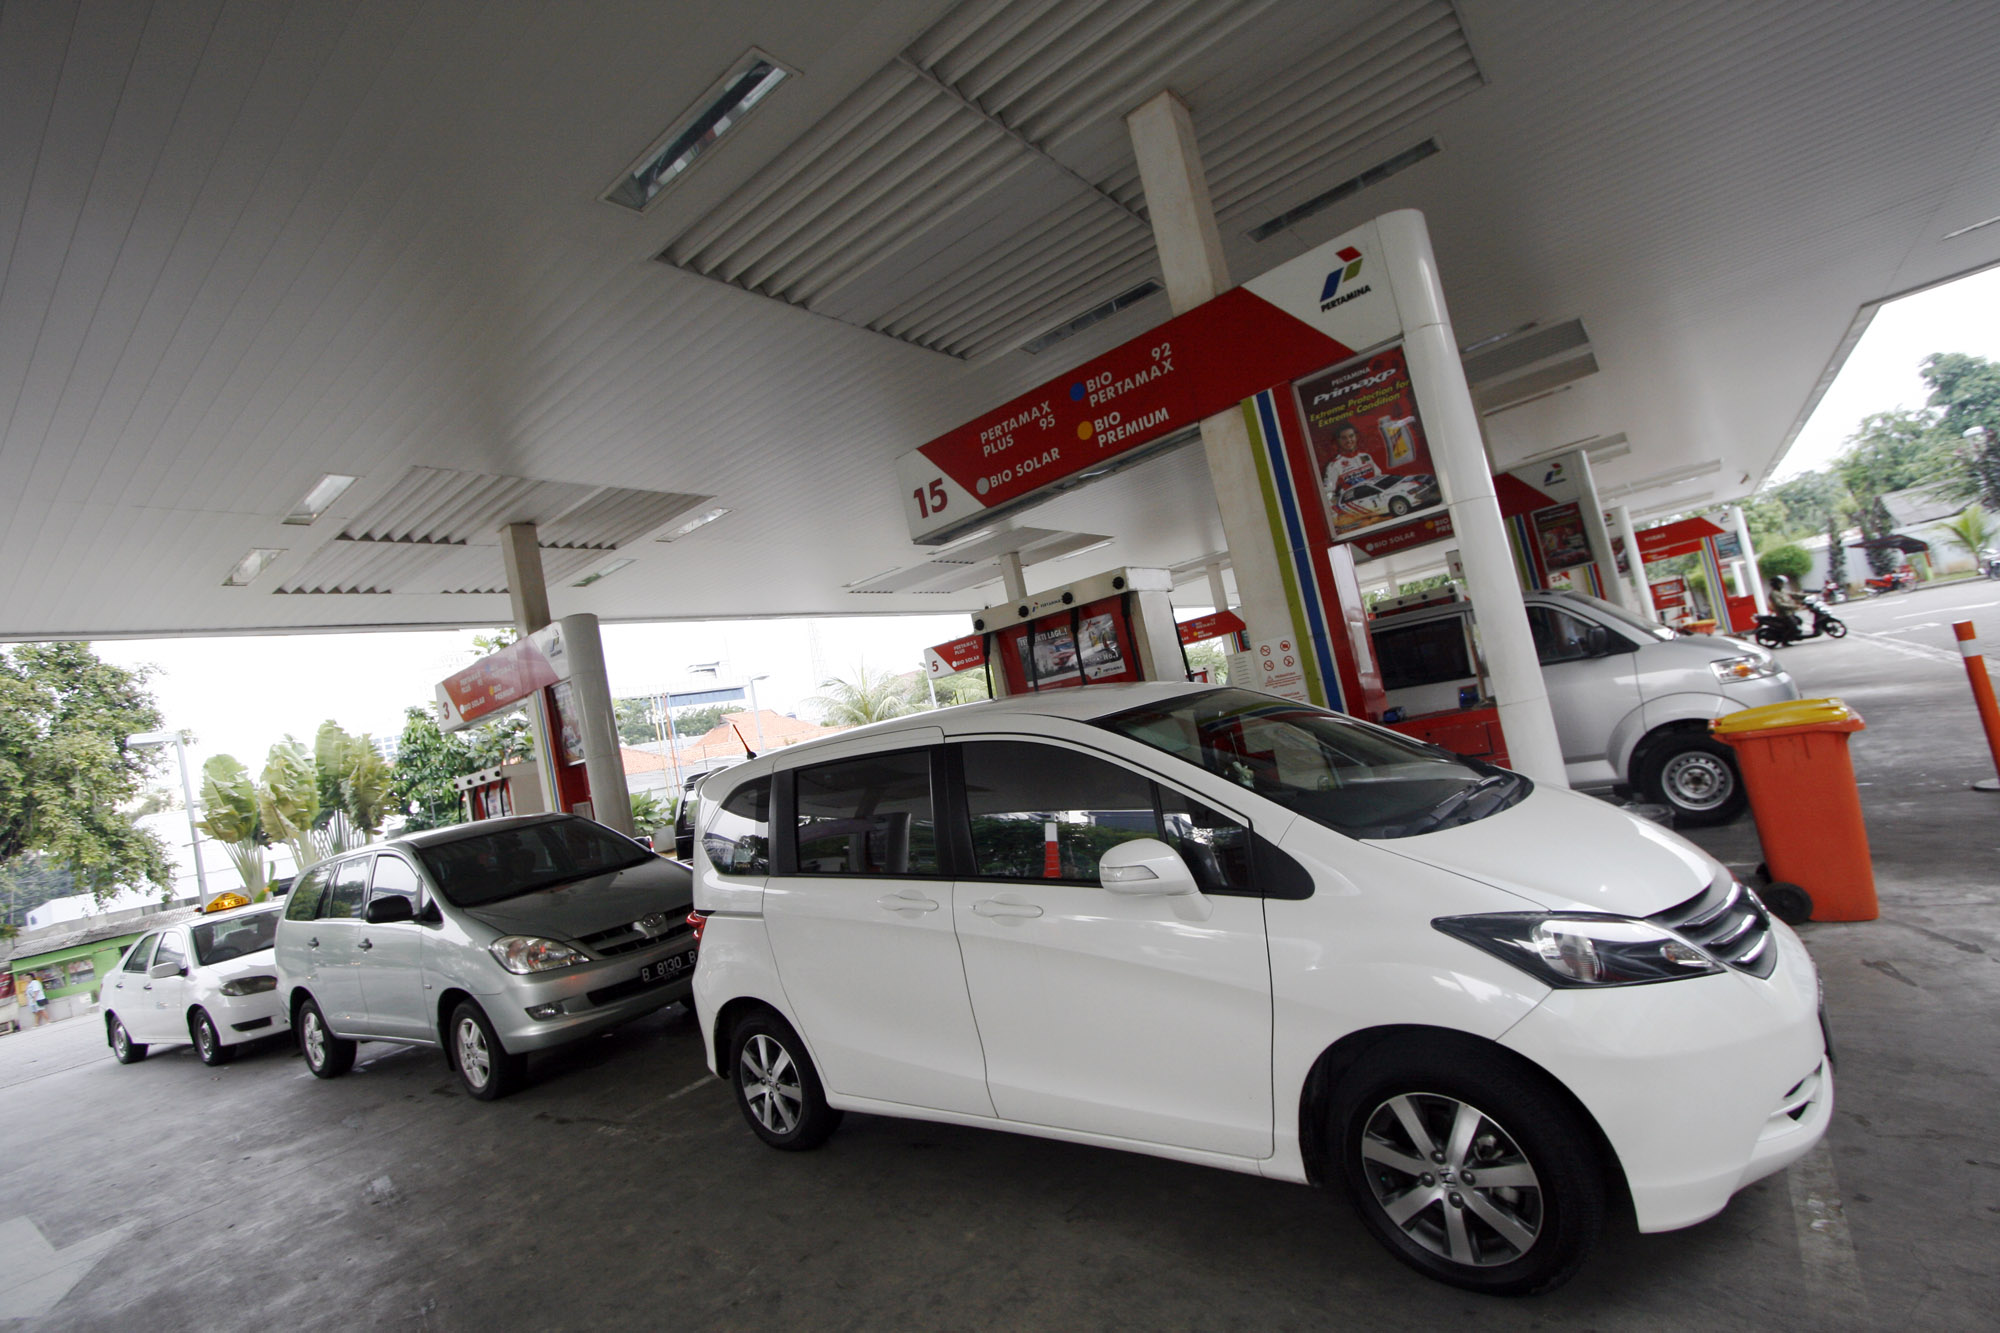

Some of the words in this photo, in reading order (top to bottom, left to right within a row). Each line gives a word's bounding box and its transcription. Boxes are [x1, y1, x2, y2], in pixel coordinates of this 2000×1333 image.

[1321, 285, 1371, 313] PERTAMINA
[1086, 371, 1112, 393] BIO
[1151, 343, 1171, 361] 92
[1089, 359, 1174, 407] PERTAMAX
[1331, 367, 1371, 387] PERTAMINA
[1310, 403, 1346, 422] Extreme
[1347, 387, 1393, 408] Protection
[1396, 379, 1410, 390] for
[1318, 410, 1354, 428] Extreme
[1356, 393, 1401, 413] Condition
[980, 401, 1051, 444] PERTAMAX
[983, 434, 1014, 457] PLUS
[1039, 414, 1056, 430] 95
[1094, 412, 1121, 433] BIO
[1097, 407, 1169, 448] PREMIUM
[989, 469, 1012, 488] BIO
[1016, 447, 1060, 478] SOLAR
[913, 477, 948, 519] 15
[1434, 518, 1449, 526] BIO
[1374, 540, 1387, 549] BIO
[1388, 531, 1415, 544] SOLAR
[931, 660, 939, 672] 5
[442, 701, 450, 720] 3
[214, 898, 244, 909] TAKSI
[641, 967, 649, 982] B
[656, 956, 682, 975] 8130
[688, 950, 696, 964] B
